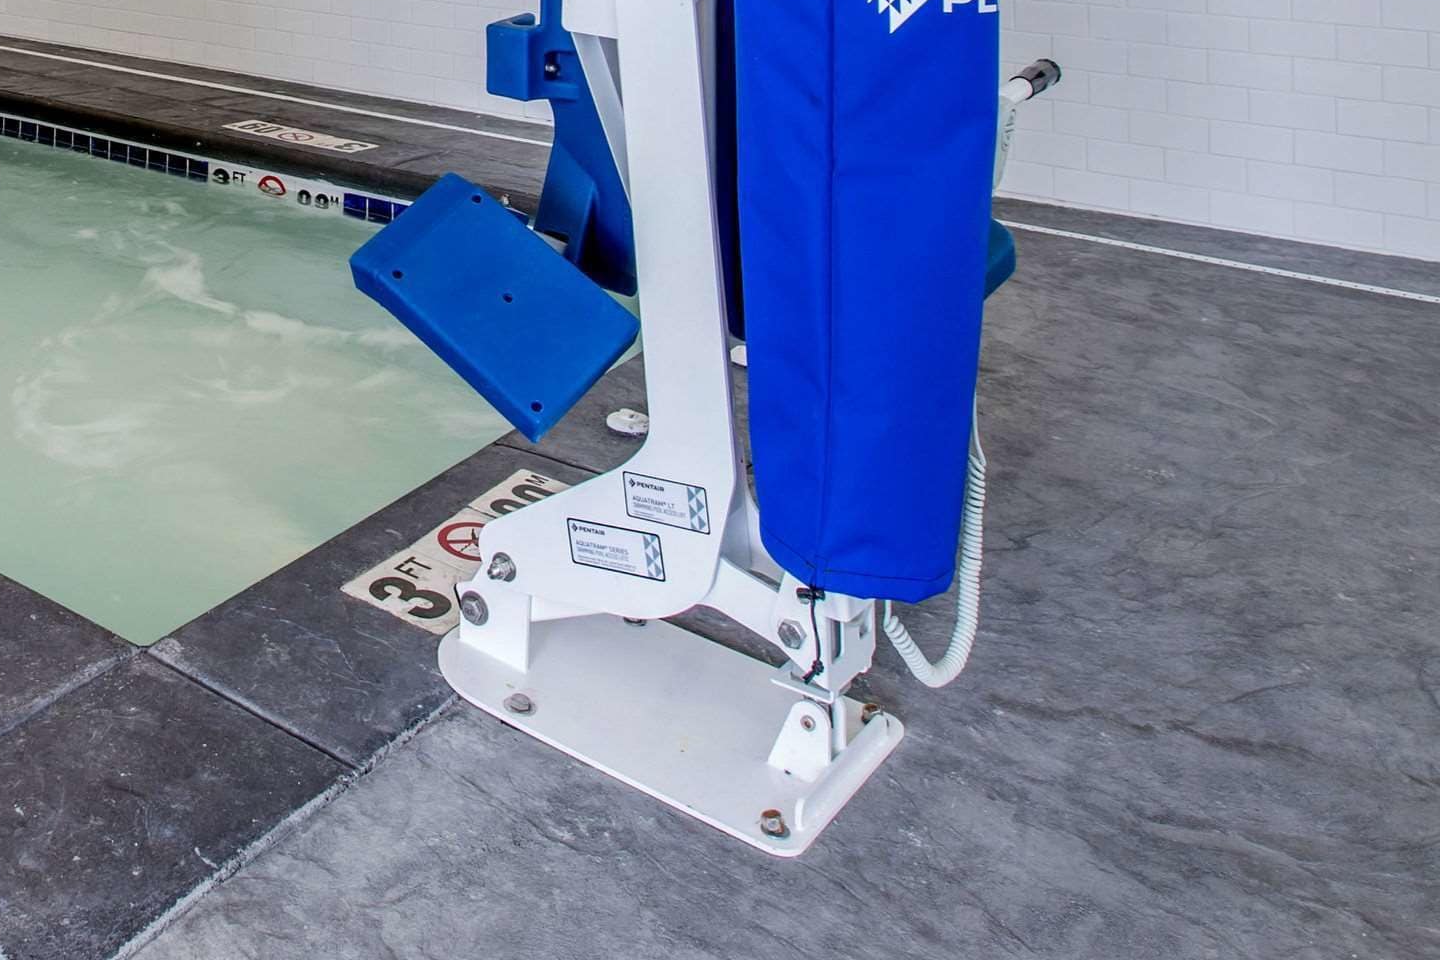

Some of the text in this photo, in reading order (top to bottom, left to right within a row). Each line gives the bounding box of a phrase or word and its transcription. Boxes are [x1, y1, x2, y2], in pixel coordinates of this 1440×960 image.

[232, 171, 246, 184] FT
[525, 474, 550, 487] M
[636, 480, 665, 492] PENTAIR
[578, 525, 606, 536] PENTAIR
[368, 556, 453, 620] 3 FT
